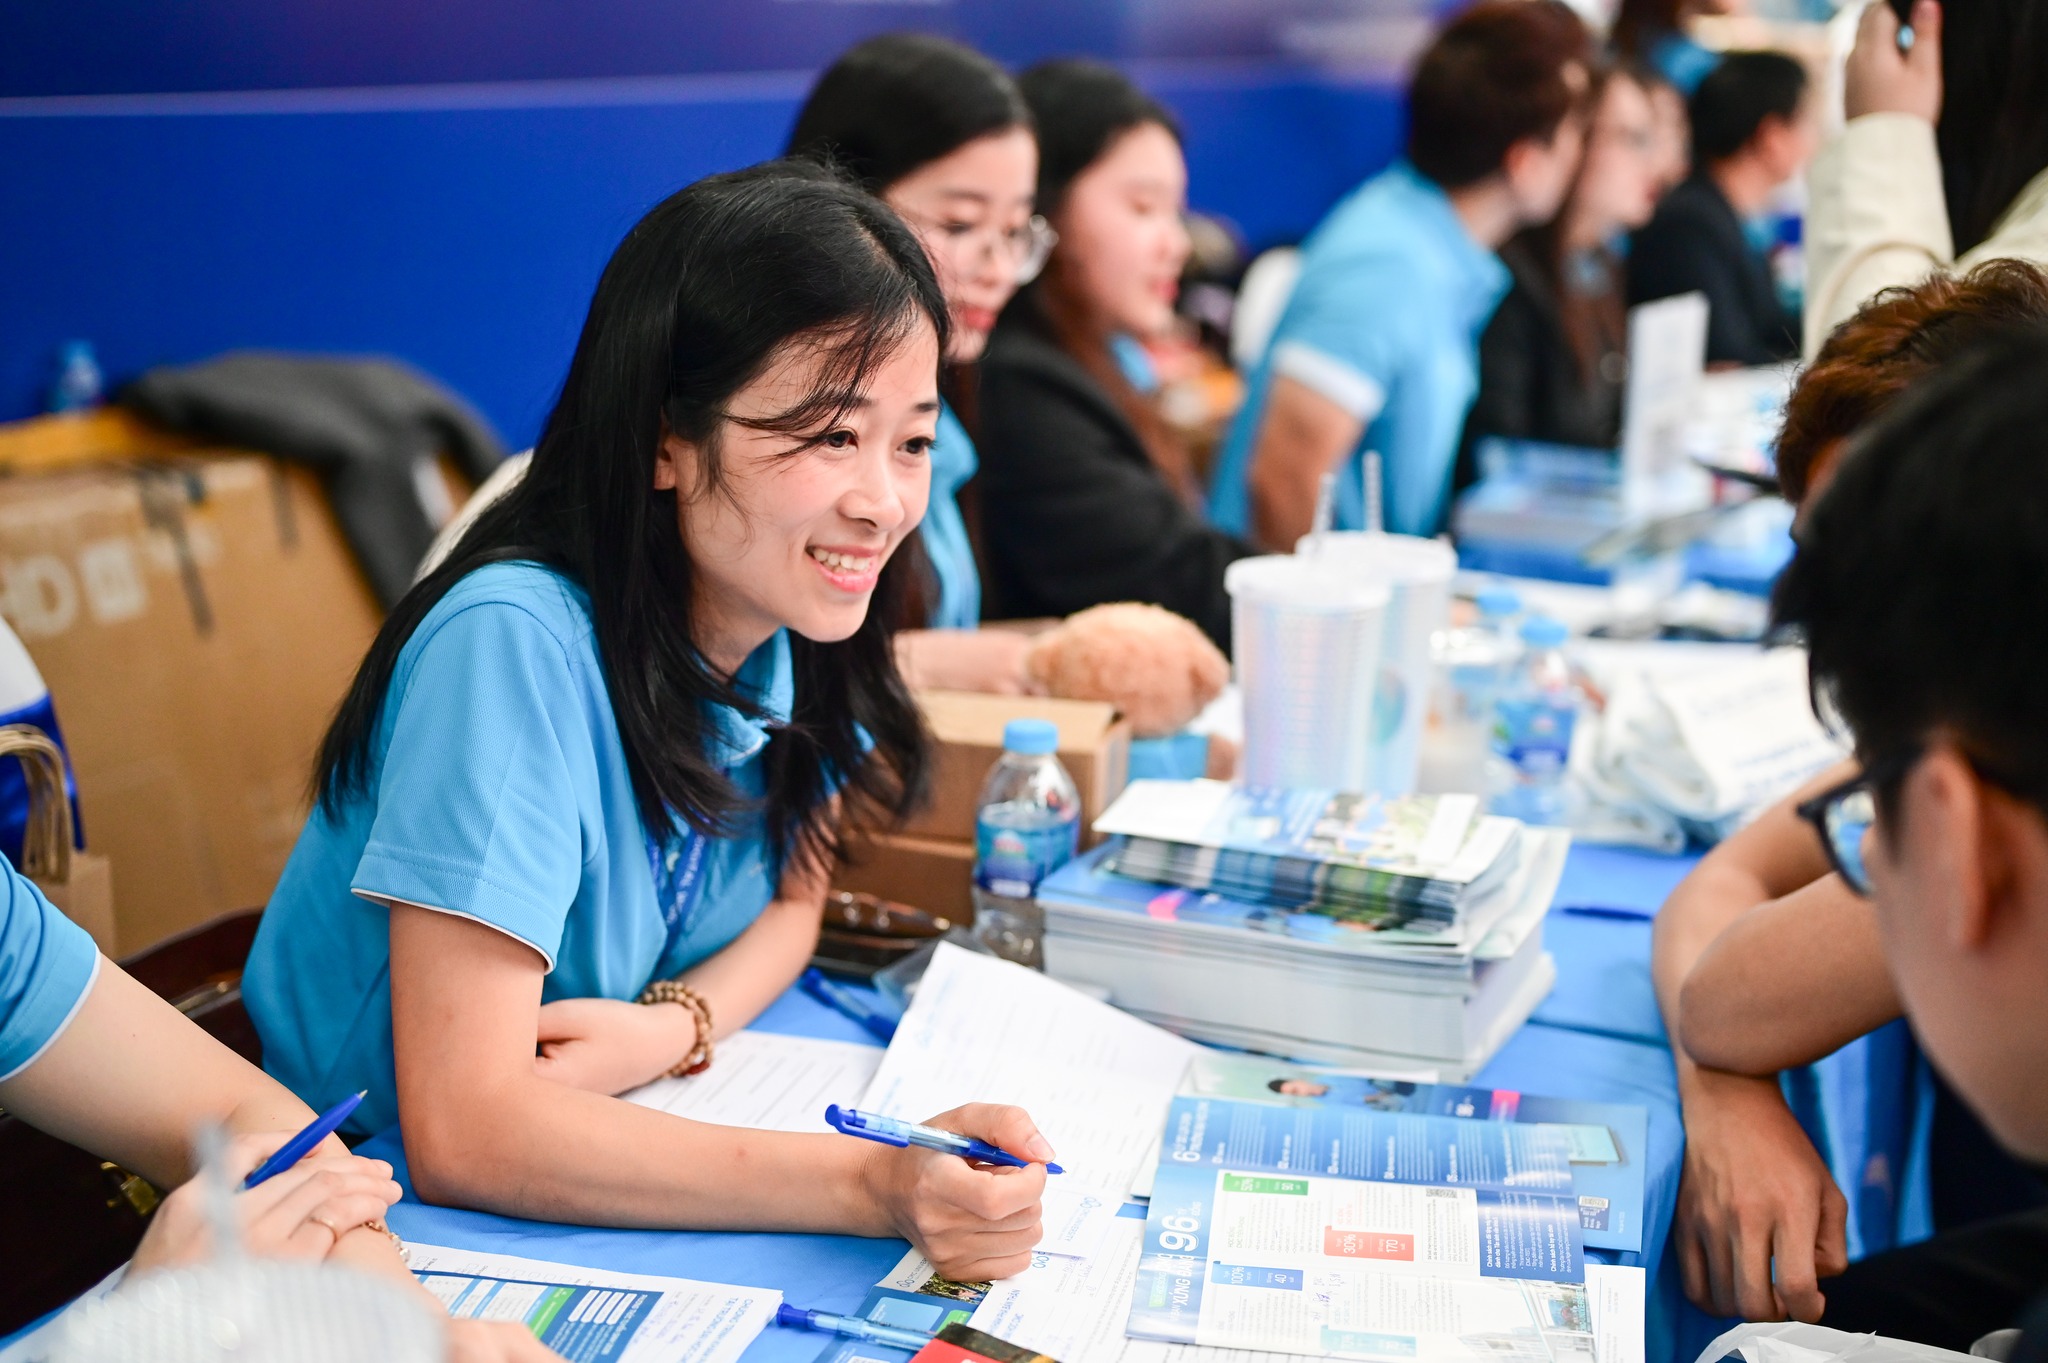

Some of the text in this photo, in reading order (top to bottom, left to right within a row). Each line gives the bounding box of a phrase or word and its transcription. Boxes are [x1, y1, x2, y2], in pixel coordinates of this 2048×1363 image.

[1158, 1214, 1201, 1251] 96
[1344, 1234, 1357, 1253] 30%
[1386, 1238, 1399, 1252] 170
